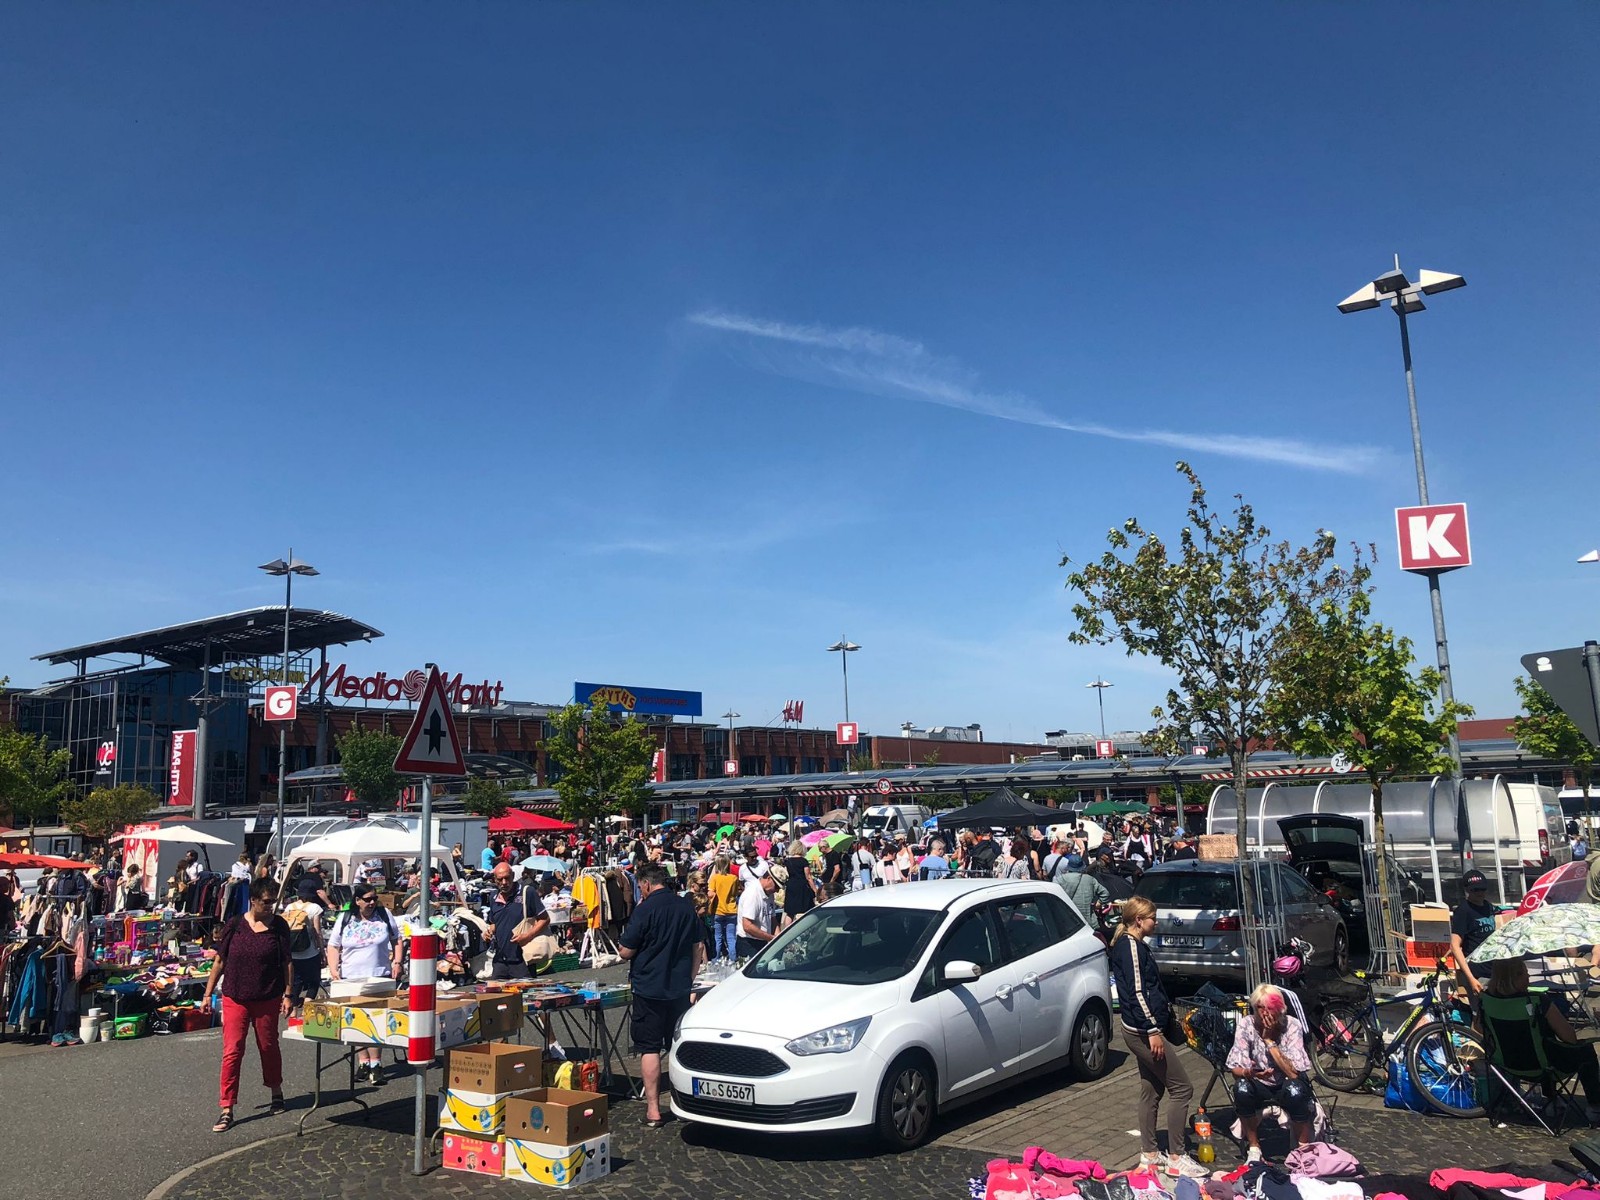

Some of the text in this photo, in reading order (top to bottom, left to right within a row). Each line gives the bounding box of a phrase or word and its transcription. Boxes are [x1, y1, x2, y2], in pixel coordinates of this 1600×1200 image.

[1408, 513, 1462, 560] K
[299, 661, 504, 707] Media Markt
[269, 691, 293, 716] G
[841, 725, 853, 741] F
[1100, 742, 1110, 755] E
[727, 762, 736, 773] B
[698, 1081, 752, 1100] KI S 6567
